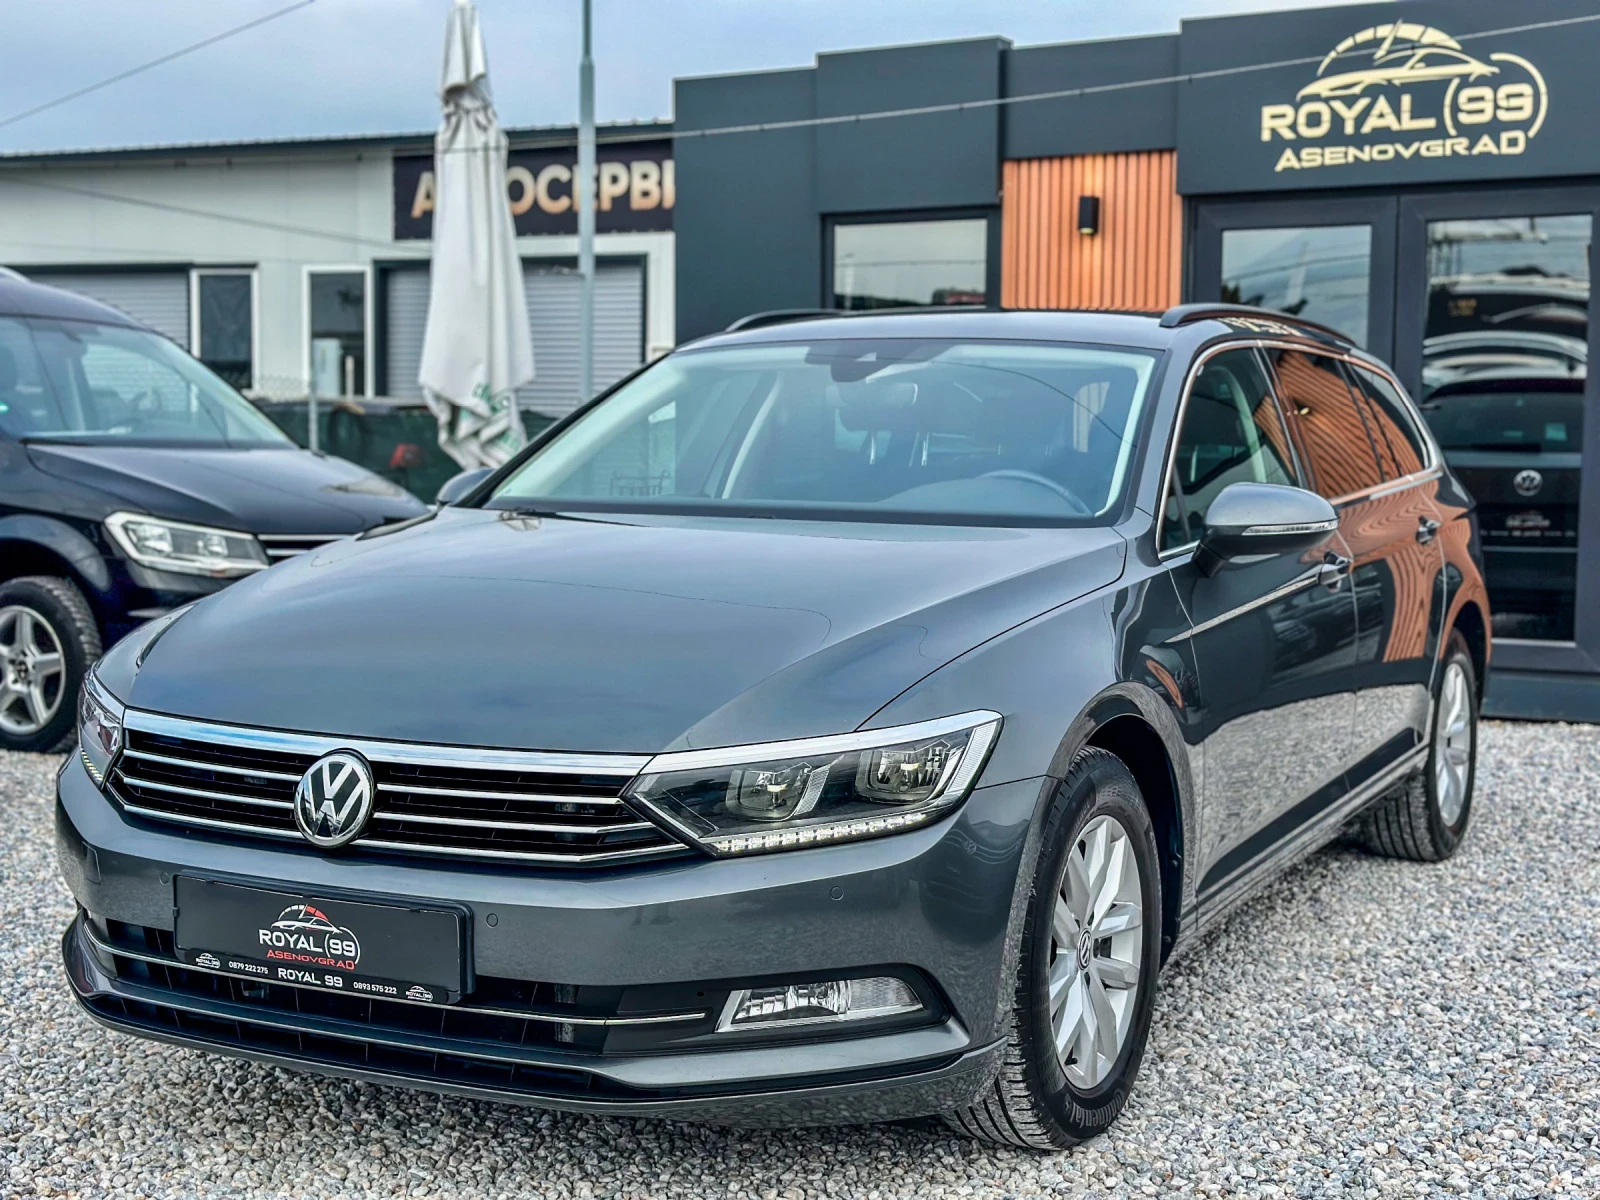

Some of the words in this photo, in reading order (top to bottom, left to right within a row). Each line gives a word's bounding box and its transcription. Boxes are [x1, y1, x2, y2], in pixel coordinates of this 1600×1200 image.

[1260, 94, 1437, 142] ROYAL
[1274, 129, 1527, 172] ASENOVGRAD
[410, 160, 676, 218] АОСРВ
[259, 929, 323, 952] ROYAL
[228, 961, 245, 970] 0879
[266, 949, 355, 970] ASENOVGRAD
[277, 968, 321, 985] ROYAL
[324, 975, 343, 988] 99
[371, 984, 384, 993] 575
[384, 986, 397, 995] 222
